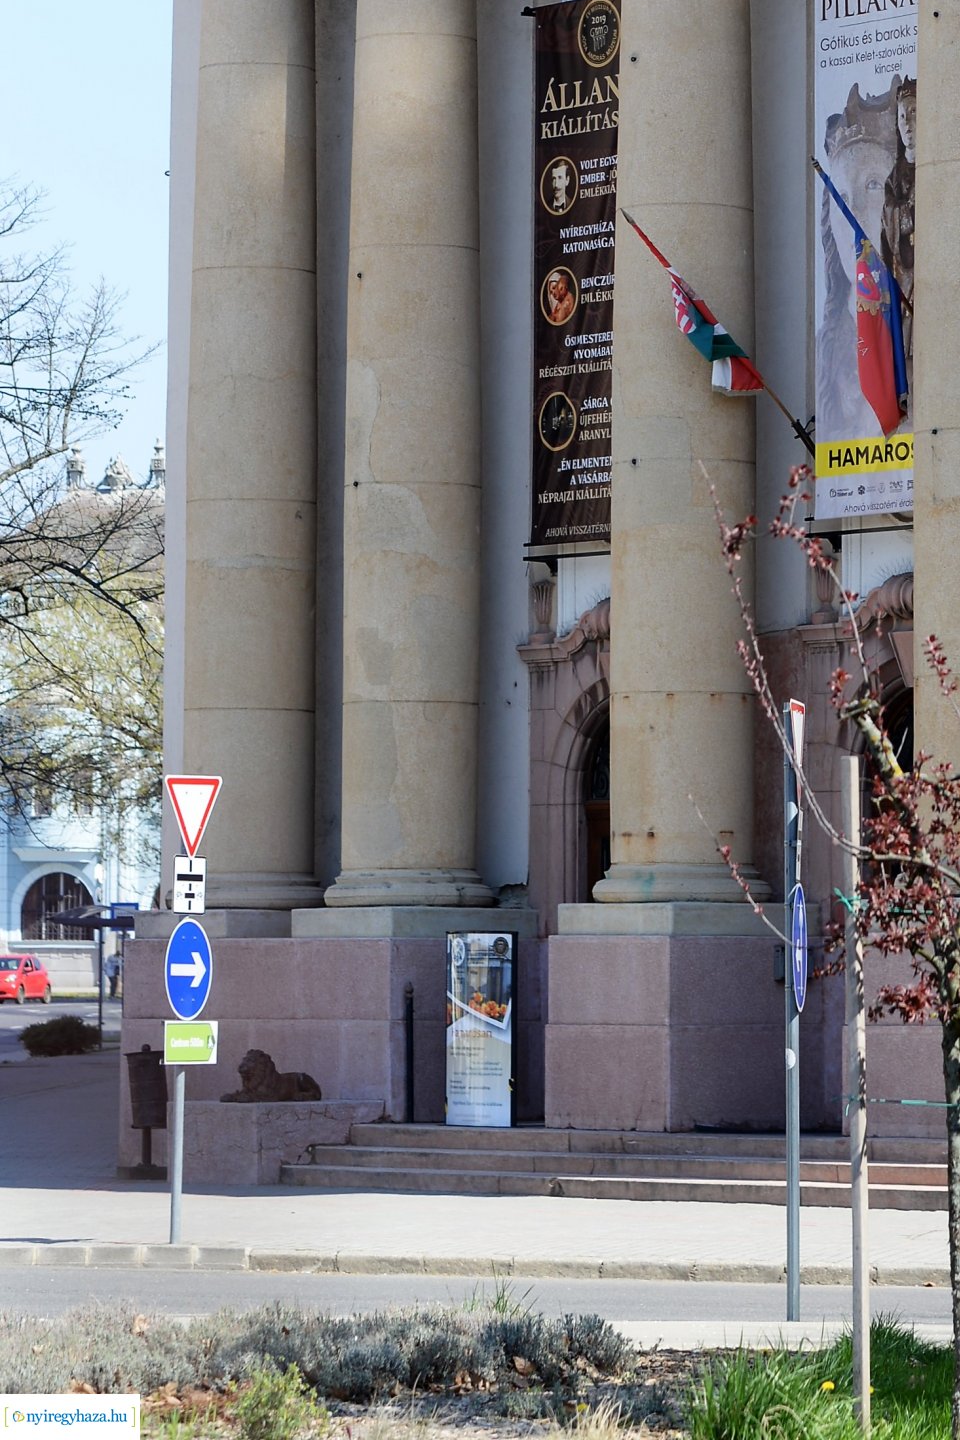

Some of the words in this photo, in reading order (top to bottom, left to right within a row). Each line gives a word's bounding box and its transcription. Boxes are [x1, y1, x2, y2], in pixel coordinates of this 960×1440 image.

[591, 15, 607, 24] 2019
[820, 34, 859, 52] Gótikus
[862, 31, 873, 45] és
[875, 25, 911, 42] barokk
[820, 59, 827, 68] a
[829, 53, 854, 68] kassai
[855, 44, 916, 64] Kelet-szlovákiai
[874, 59, 903, 75] kincsei
[540, 107, 619, 140] KIÁLLÍTÁS
[580, 158, 598, 170] VOLT
[580, 171, 606, 185] EMBER
[560, 220, 615, 239] NYÍREGYHÁZA
[563, 235, 615, 254] KATONASÁGA
[539, 364, 576, 379] RÉGÉSZETI
[828, 441, 913, 469] HAMARO
[570, 475, 576, 485] A
[538, 491, 574, 504] NÉPRAJZI
[545, 525, 568, 538] AHOVÁ
